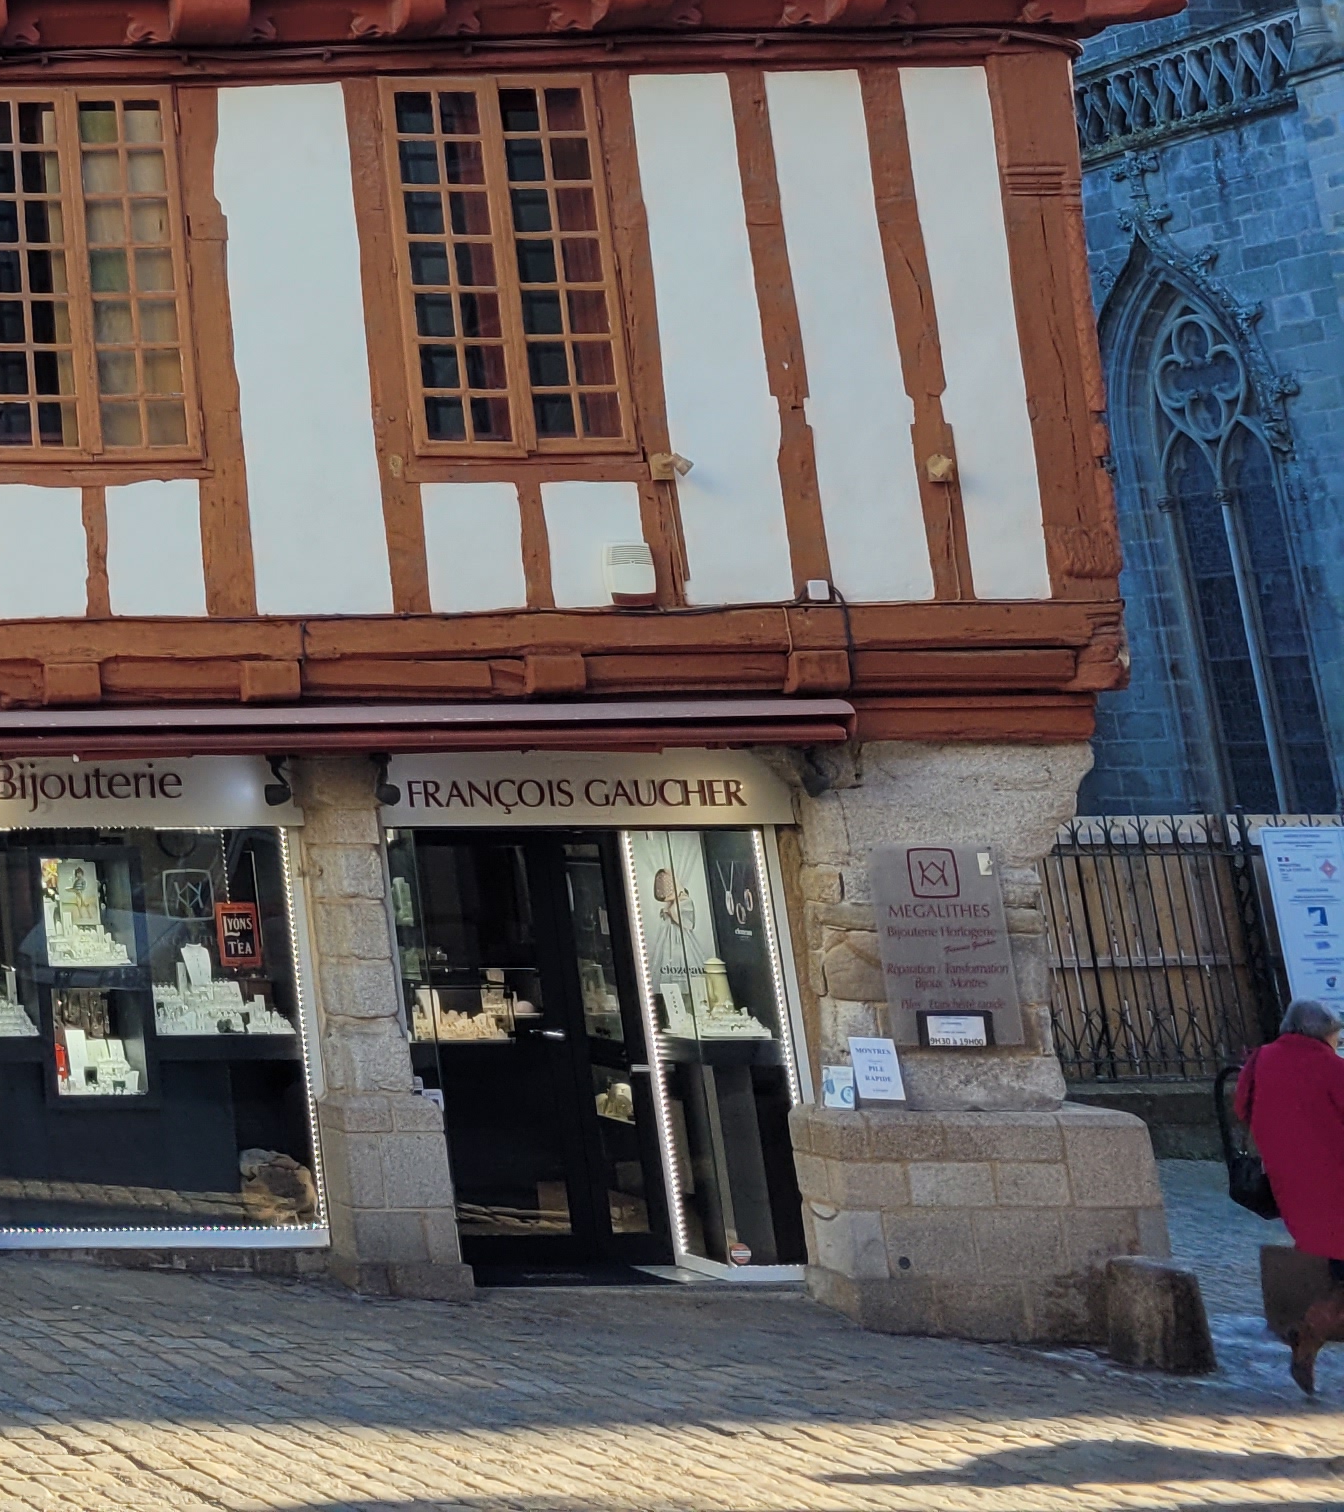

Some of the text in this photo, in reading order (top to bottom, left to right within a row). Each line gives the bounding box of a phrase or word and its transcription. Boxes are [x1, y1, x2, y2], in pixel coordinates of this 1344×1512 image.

[407, 778, 748, 814] FRANÇOIS GAUCHER
[887, 927, 938, 941] Bijouterie
